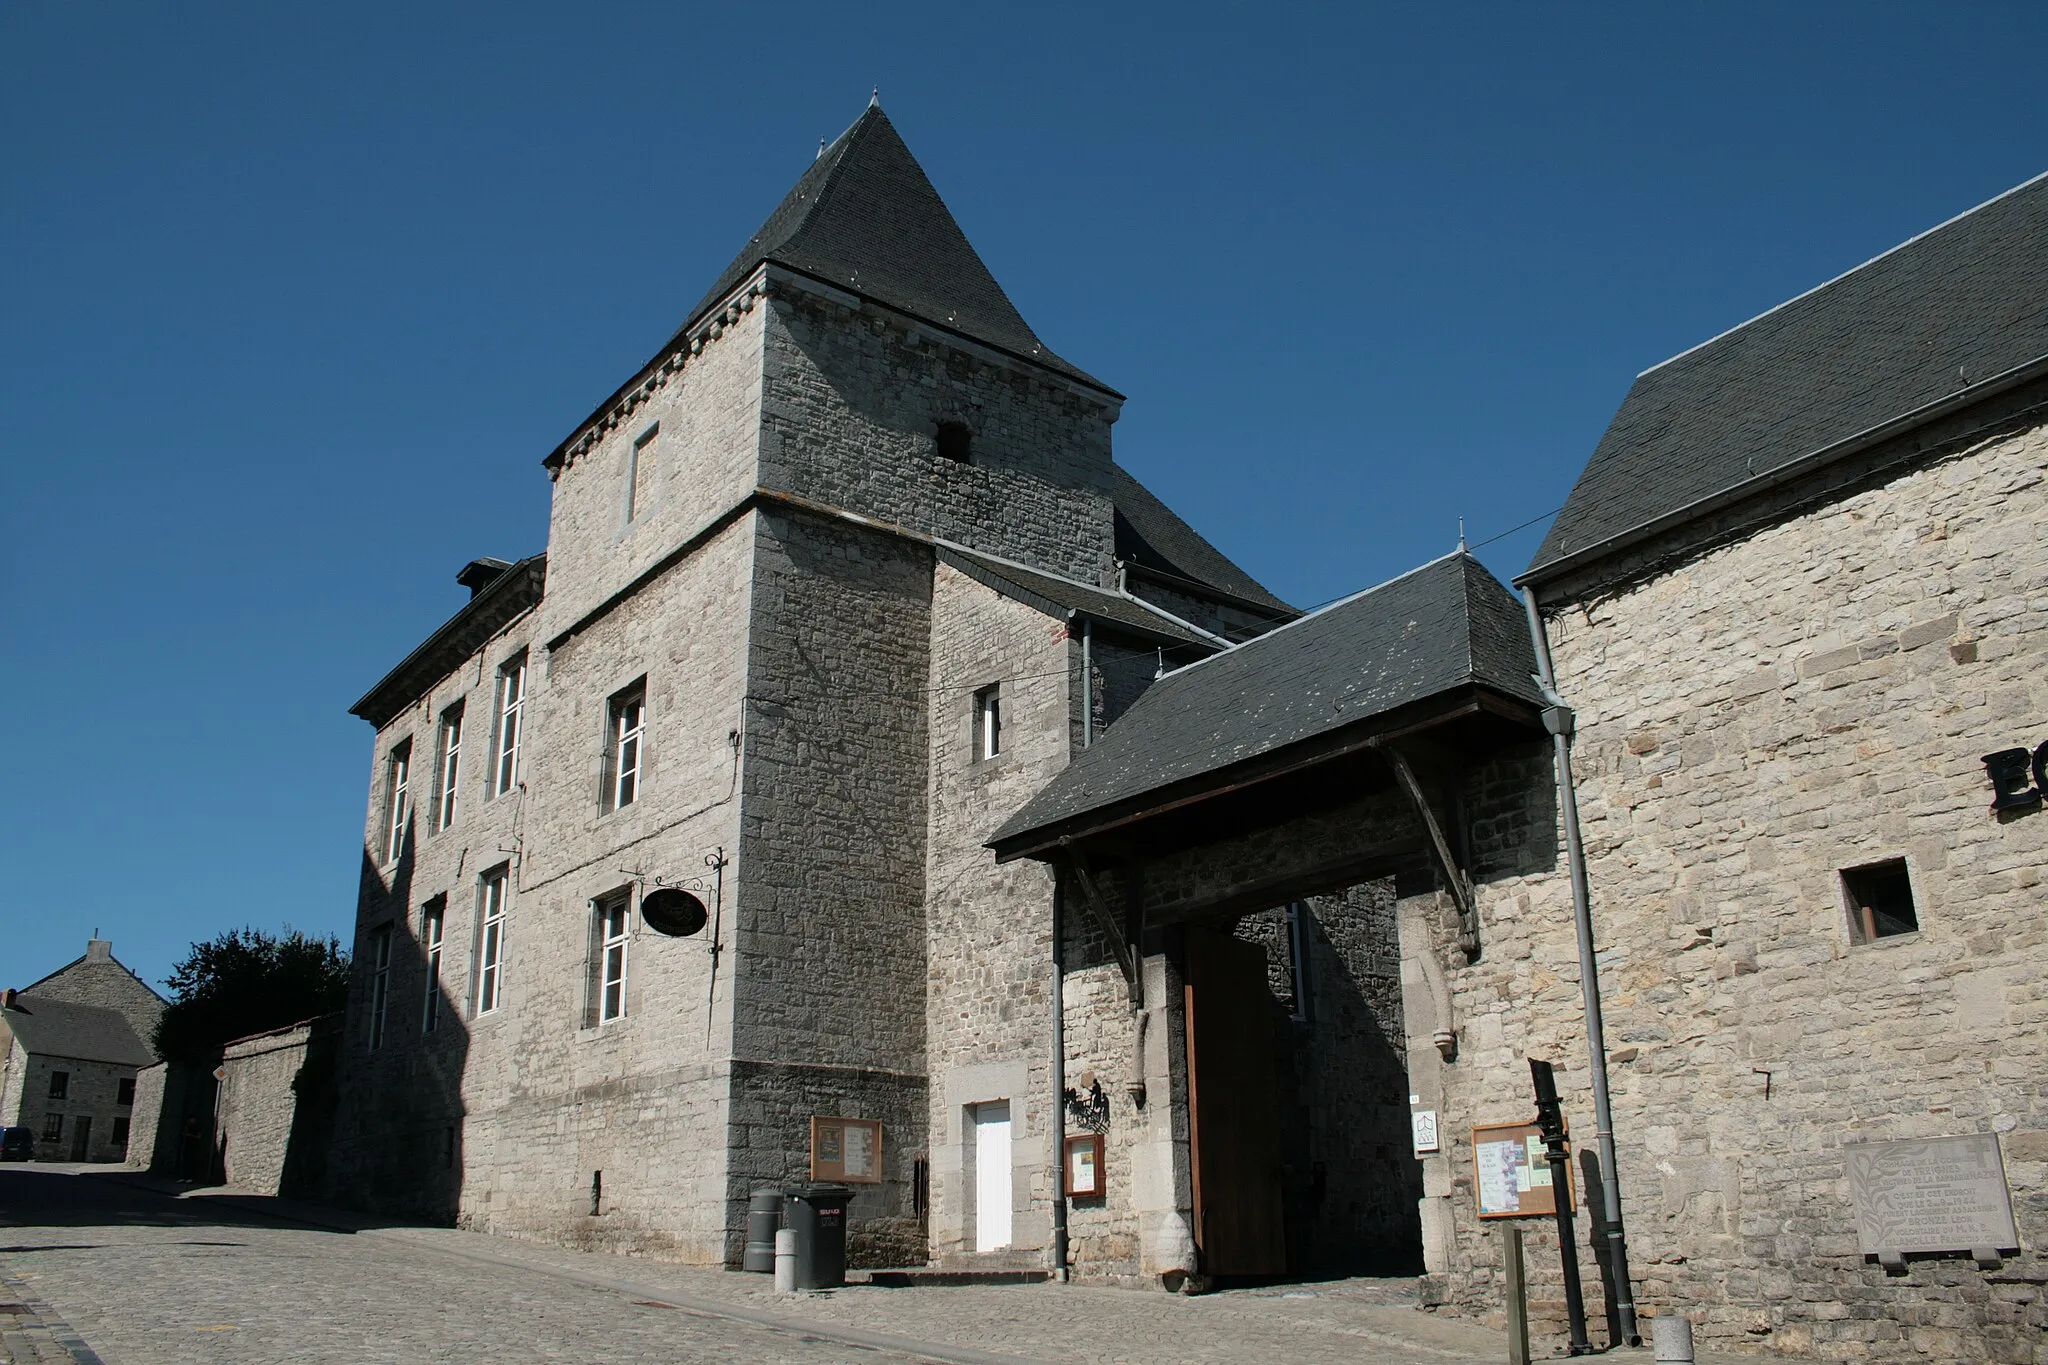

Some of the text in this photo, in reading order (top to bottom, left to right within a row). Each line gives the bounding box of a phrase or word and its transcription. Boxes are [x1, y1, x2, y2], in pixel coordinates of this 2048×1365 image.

[1980, 739, 2048, 809] E
[1915, 1165, 1960, 1176] TREIGNES
[1935, 1173, 1970, 1182] BARBARIE
[1970, 1170, 1997, 1179] NAZIE
[1926, 1190, 1941, 1198] CET
[1943, 1187, 1976, 1196] ENDROIT
[1897, 1200, 1913, 1209] QUE
[1908, 1216, 1947, 1225] BRONZE
[1893, 1227, 1940, 1236] VOLONTAIRE
[1942, 1226, 1953, 1234] DU
